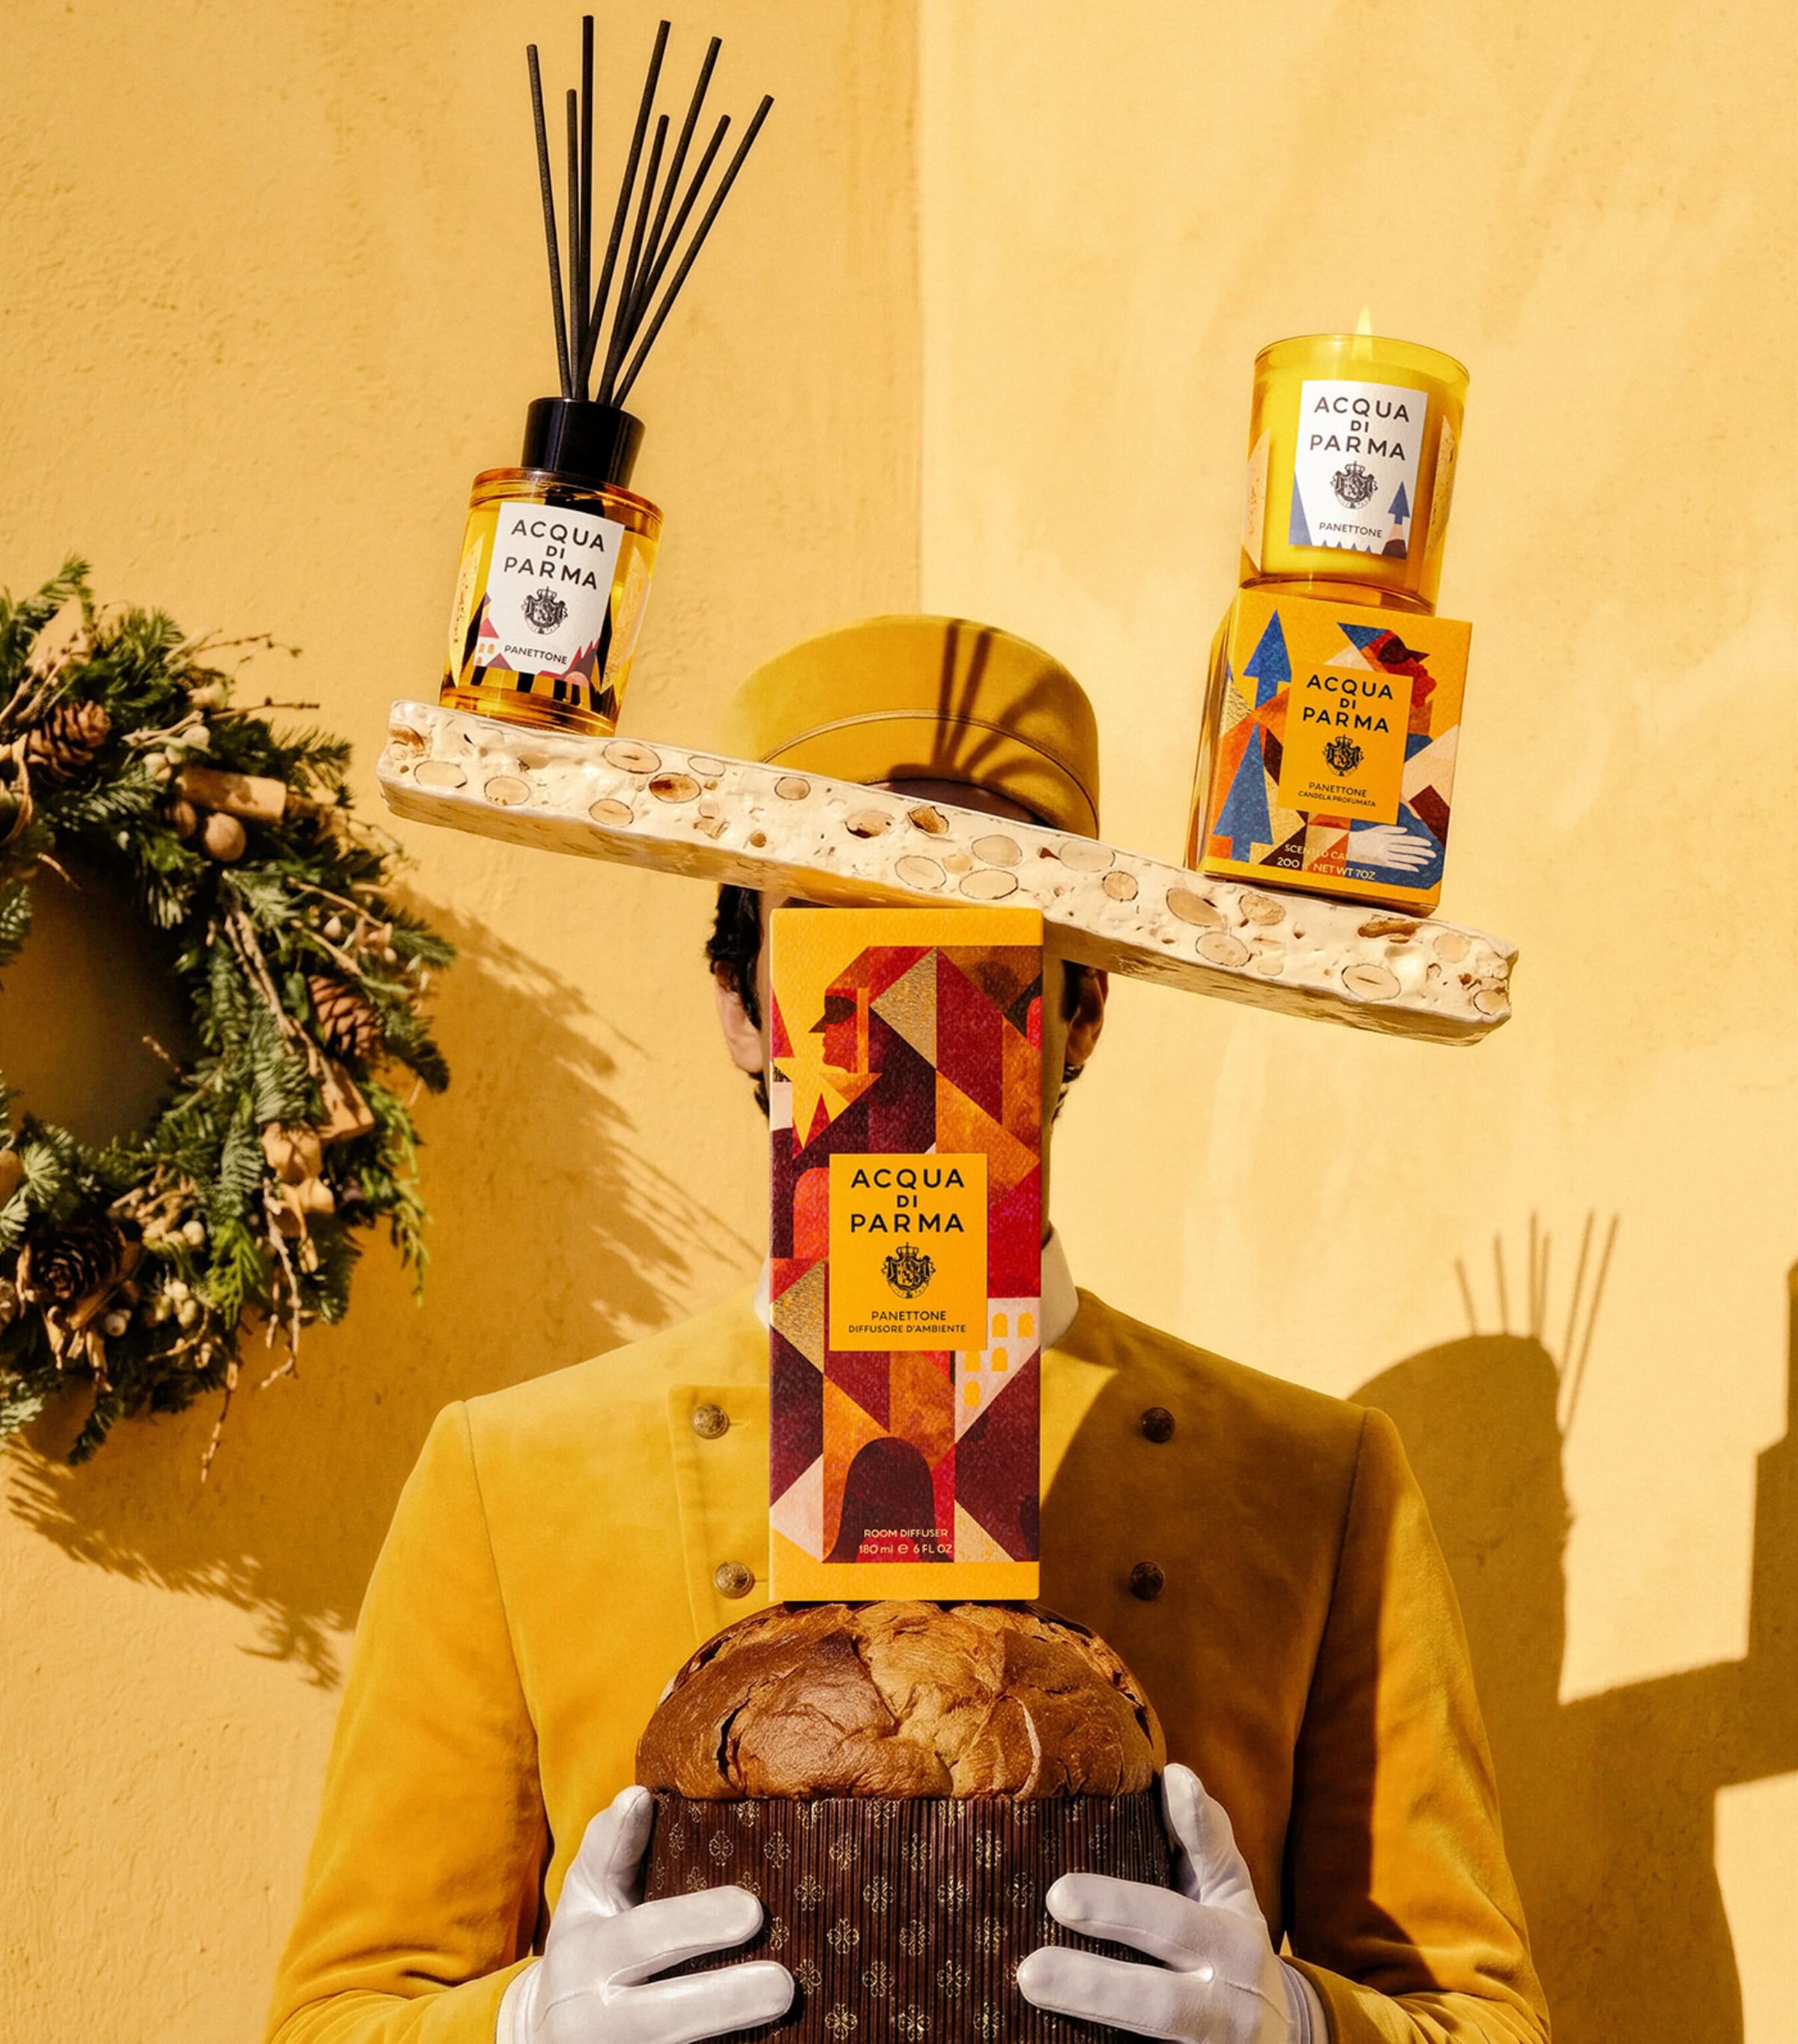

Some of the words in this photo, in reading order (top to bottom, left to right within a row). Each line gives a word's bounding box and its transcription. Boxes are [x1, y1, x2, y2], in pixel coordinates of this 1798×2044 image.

[1314, 396, 1409, 422] ACQUA
[1350, 420, 1369, 432] DI
[1310, 434, 1405, 461] PARMA
[511, 519, 605, 552] ACQUA
[1319, 522, 1383, 539] PANETTONE
[545, 545, 565, 559] DI
[503, 557, 597, 589] PARMA
[504, 645, 568, 664] PANETTONE
[1306, 674, 1393, 700] ACQUA
[1340, 697, 1356, 709] DI
[1302, 706, 1389, 733] PARMA
[1298, 790, 1331, 801] CANDELA
[1309, 782, 1366, 797] PANETTONE
[1277, 857, 1300, 868] 200
[1313, 863, 1334, 873] NET
[1336, 865, 1354, 876] WT
[850, 1168, 965, 1189] ACQUA
[897, 1195, 918, 1208] DI
[850, 1213, 965, 1233] PARMA
[871, 1311, 946, 1320] PANETTONE
[849, 1325, 903, 1333] DIFFUSORE
[906, 1324, 966, 1332] D'AMBIENTE
[864, 1529, 898, 1538] ROOM
[900, 1529, 948, 1538] DIFFUSER
[859, 1544, 878, 1554] 180
[880, 1544, 894, 1553] ml
[913, 1544, 920, 1554] 6
[922, 1544, 935, 1553] FL
[937, 1544, 953, 1553] OZ
